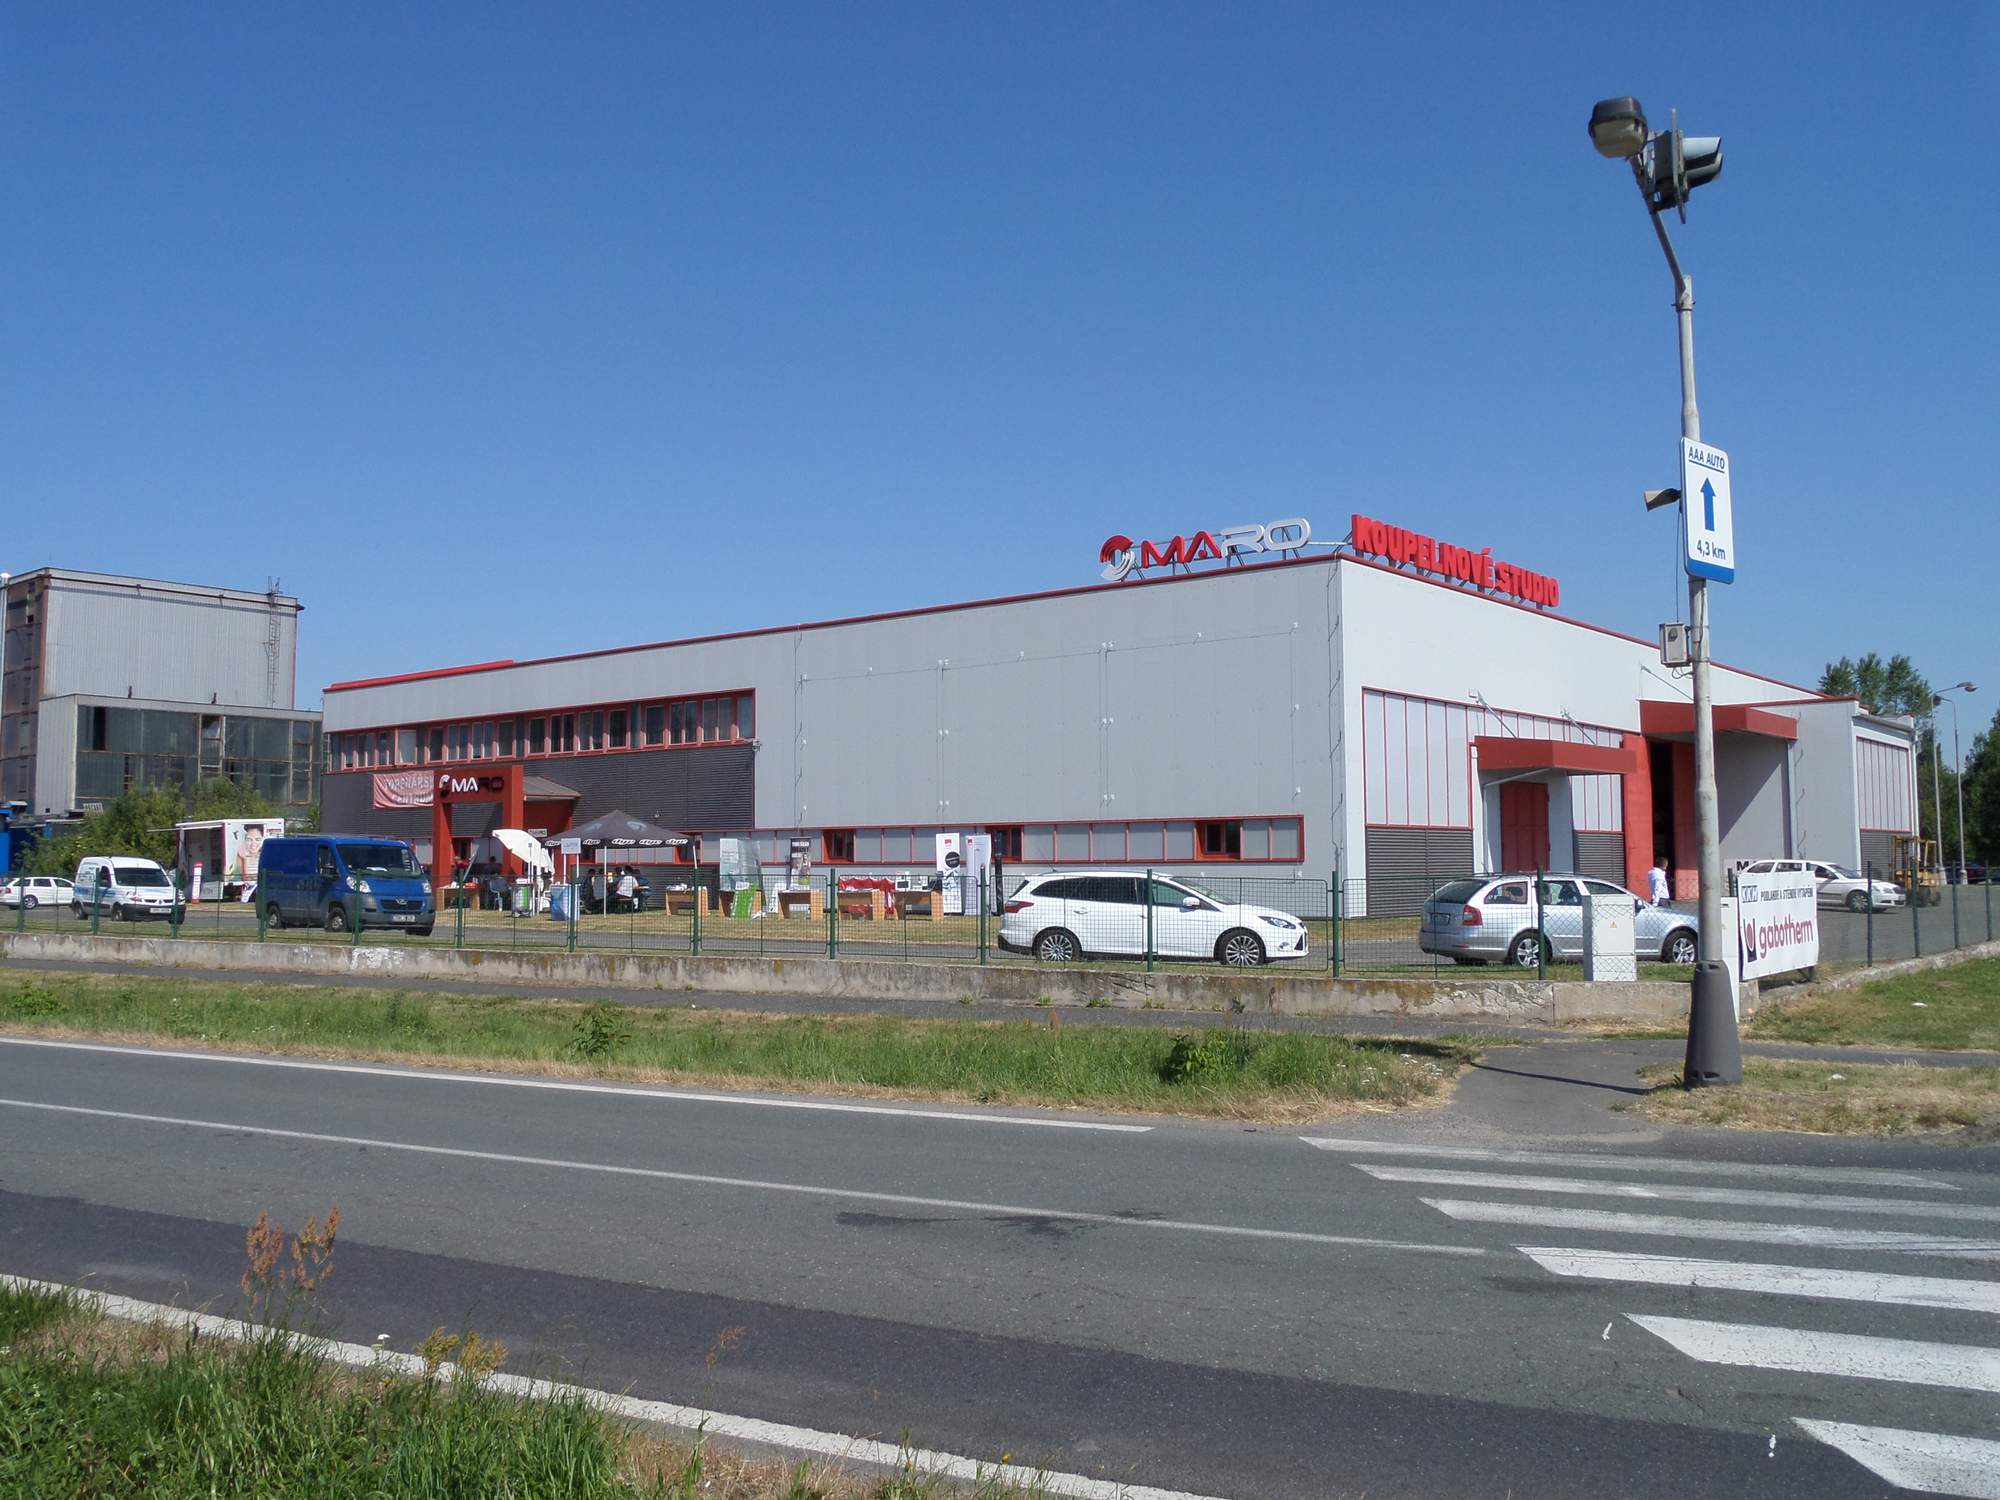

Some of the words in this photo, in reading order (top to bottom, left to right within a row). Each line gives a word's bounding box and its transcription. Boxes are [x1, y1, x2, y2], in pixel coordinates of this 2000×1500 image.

[1688, 446, 1704, 463] AAA
[1706, 452, 1726, 470] AUTO
[1140, 517, 1312, 569] MARO
[1351, 513, 1494, 589] KOUPELNOVÉ
[1495, 561, 1560, 608] STUDIO
[1696, 540, 1711, 557] 4,3
[1712, 541, 1726, 561] km
[1760, 913, 1814, 959] gabotherm
